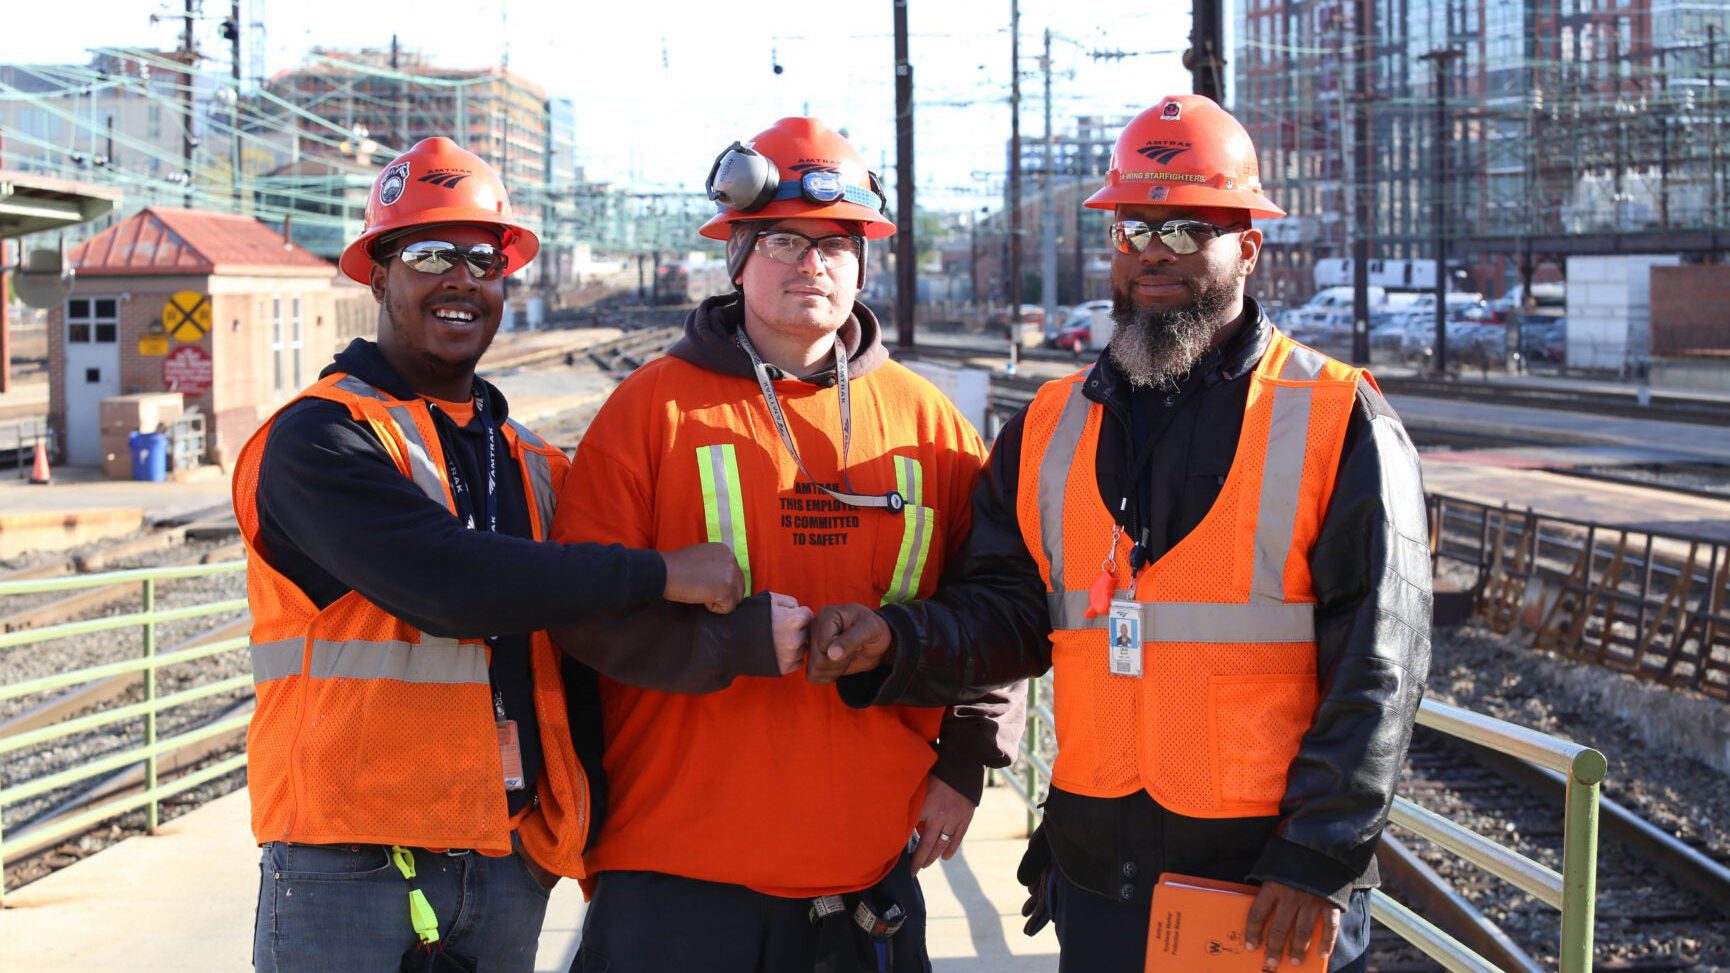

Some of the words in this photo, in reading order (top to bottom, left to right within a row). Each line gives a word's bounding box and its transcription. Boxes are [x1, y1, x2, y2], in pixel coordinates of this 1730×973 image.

[1145, 174, 1206, 182] STARFIGHTERS
[839, 362, 847, 403] AMTRAK
[764, 382, 782, 421] AMTRAK
[488, 427, 496, 478] AMTRAK
[780, 498, 804, 510] THIS
[806, 499, 860, 512] EMPLOYE
[781, 515, 792, 528] IS
[794, 516, 859, 528] COMMITTED
[793, 533, 806, 545] TO
[809, 533, 848, 546] SAFETY
[1210, 942, 1220, 952] W
